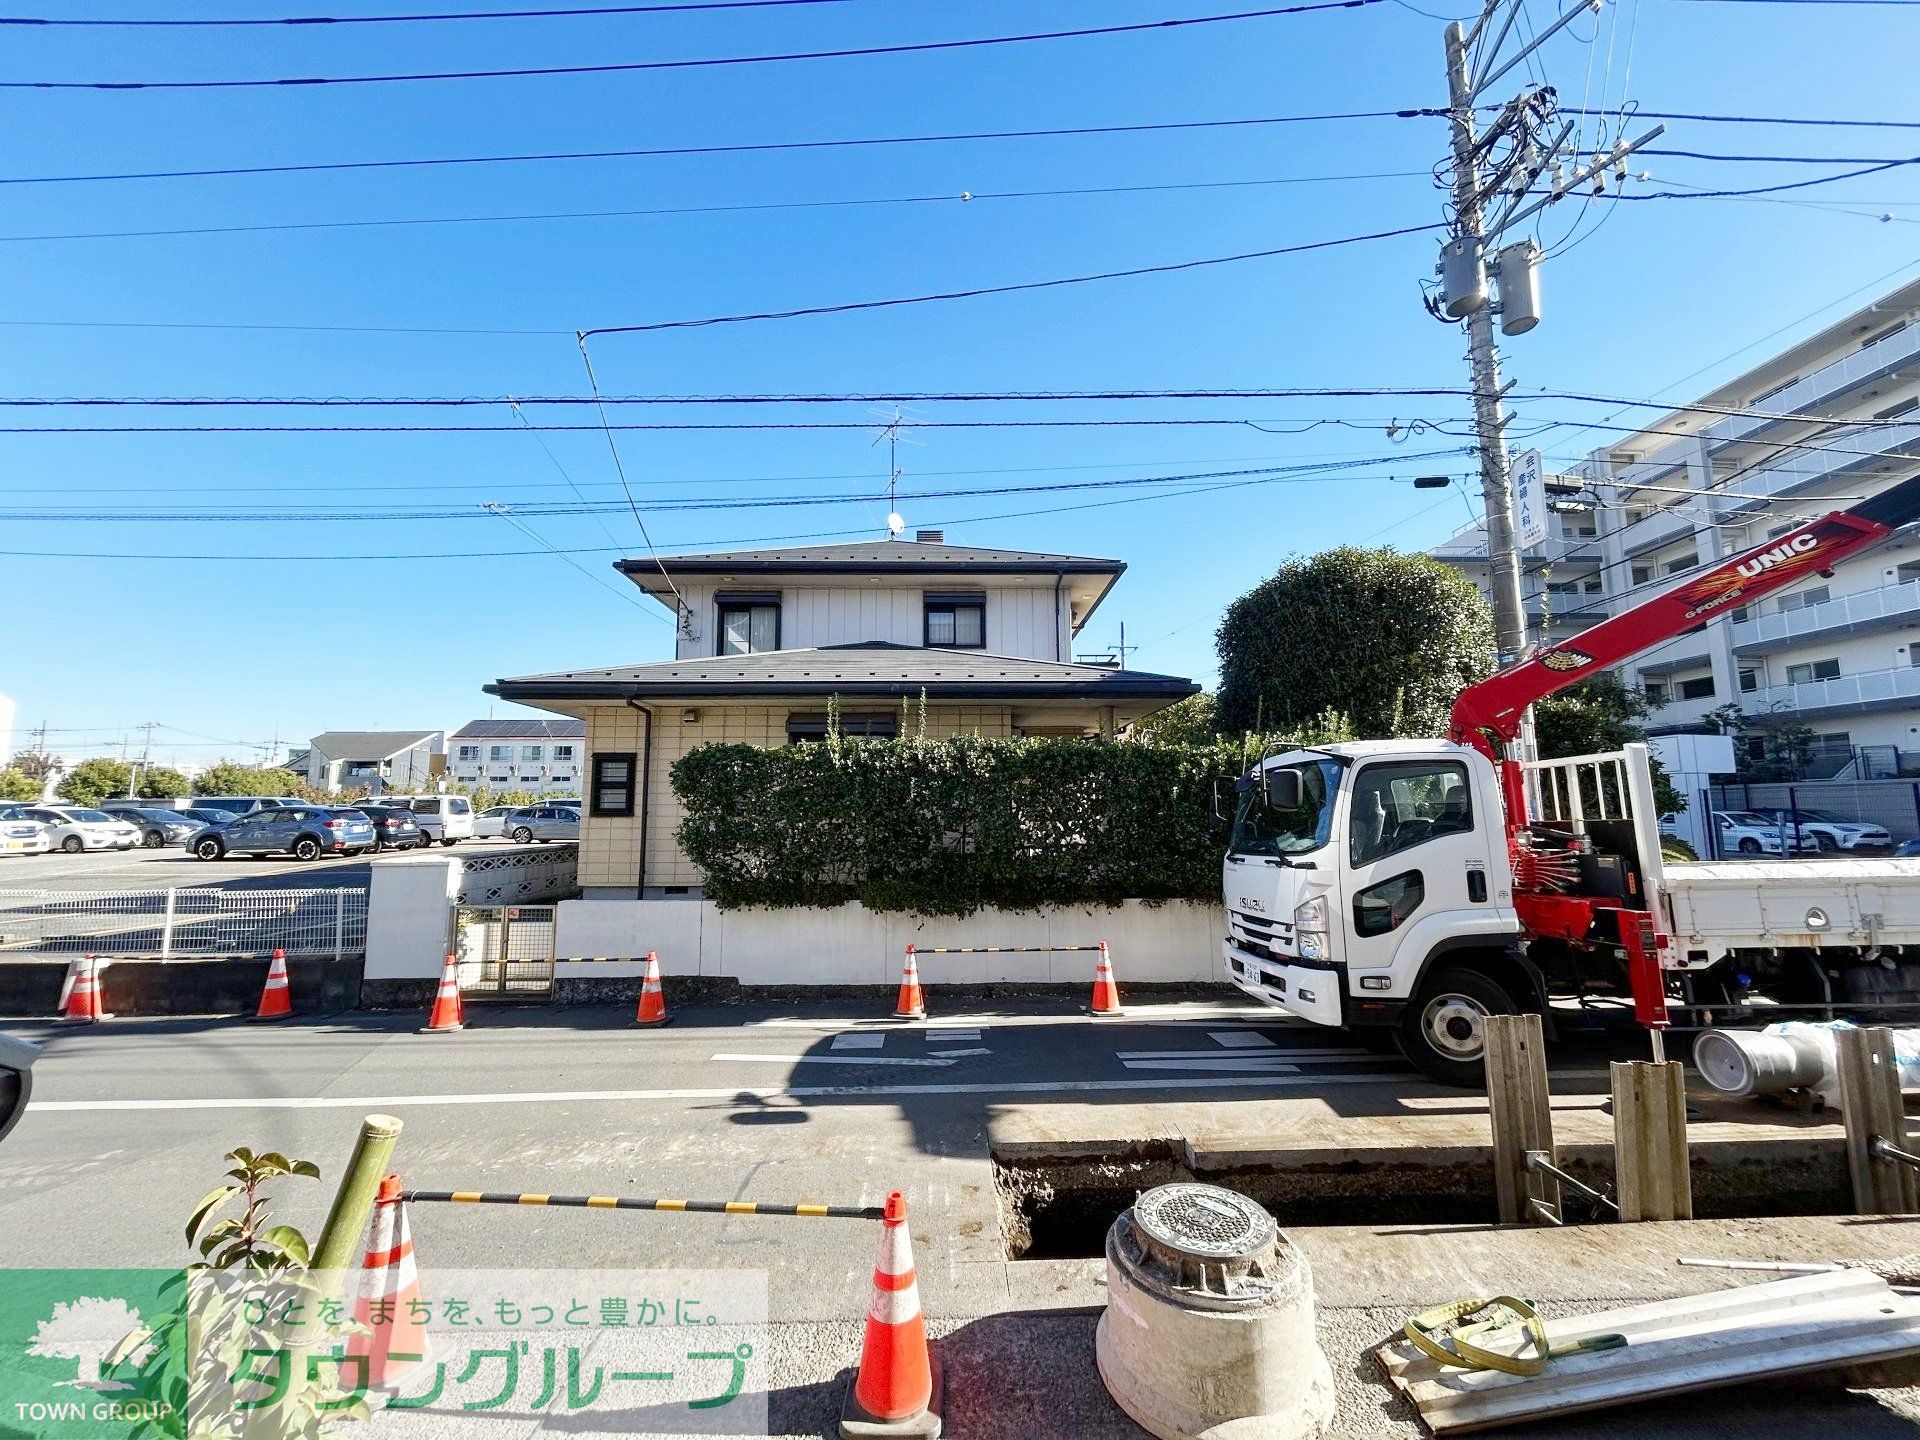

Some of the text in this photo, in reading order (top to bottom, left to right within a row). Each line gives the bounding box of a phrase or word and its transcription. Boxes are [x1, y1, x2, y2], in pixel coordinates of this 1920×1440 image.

[1525, 455, 1537, 484] 会沢
[1518, 472, 1532, 528] 産婦人科
[1736, 533, 1818, 578] UNIC
[1685, 588, 1743, 619] G-FORCE
